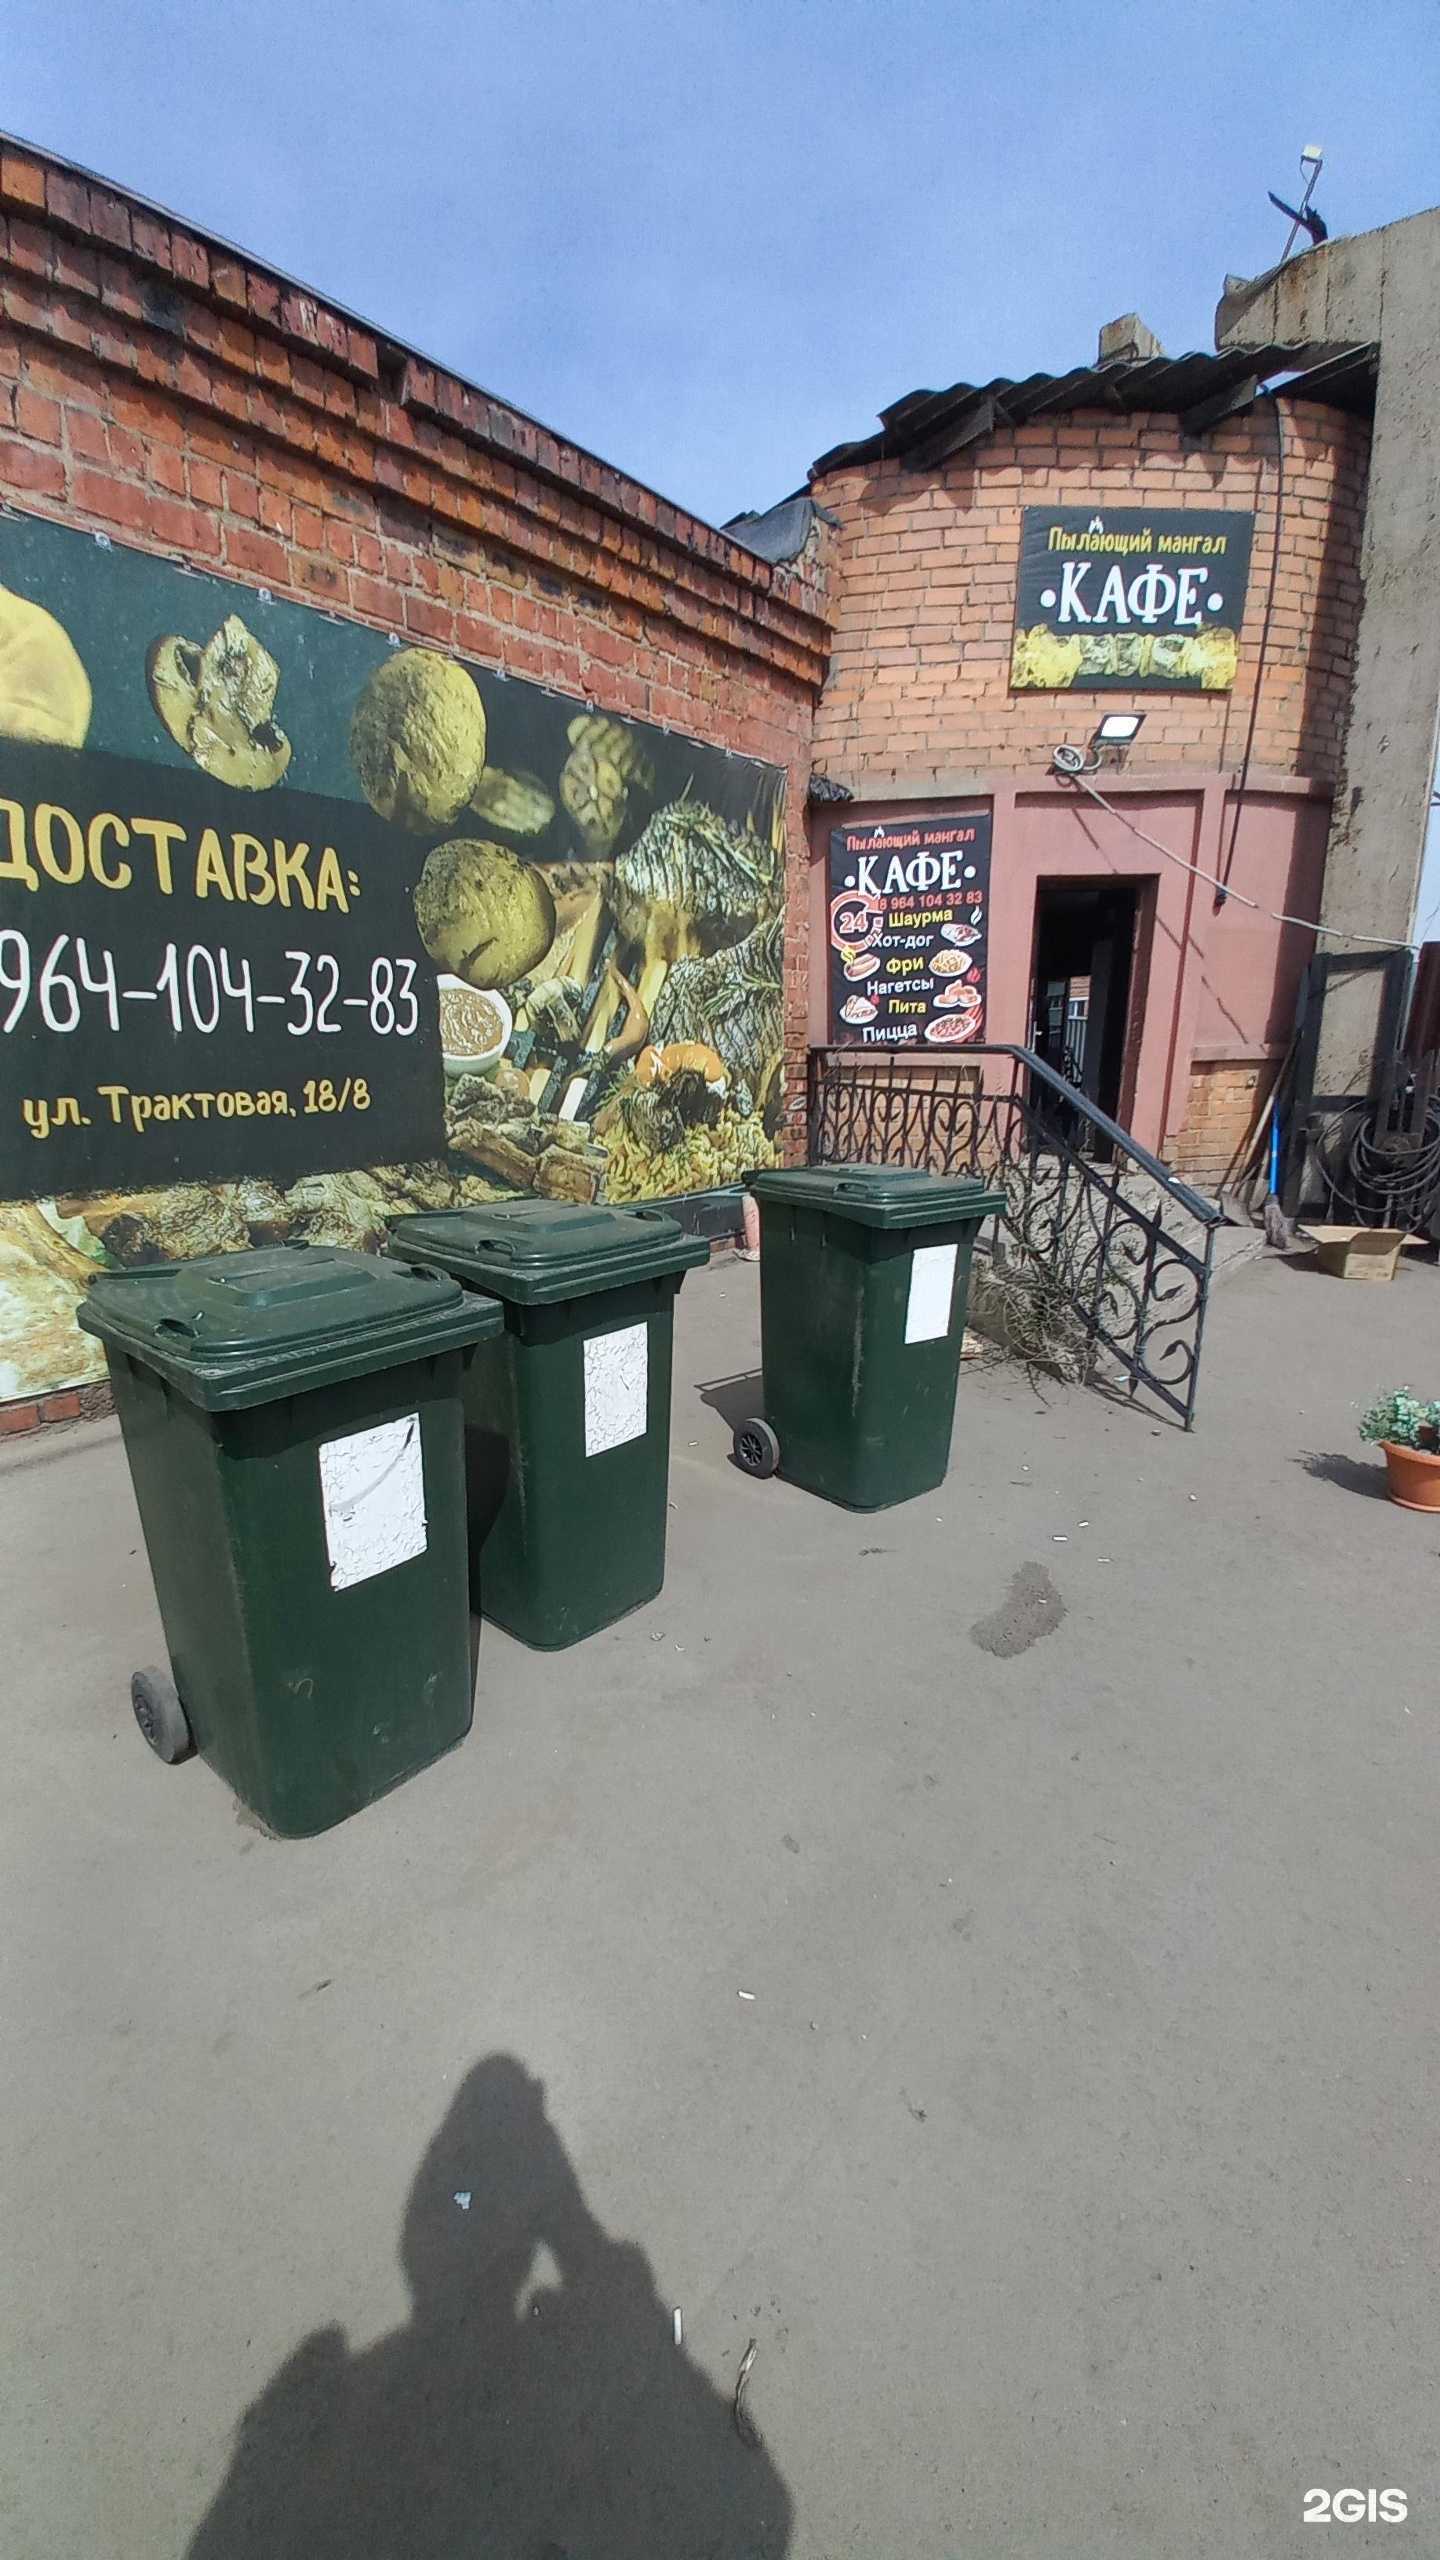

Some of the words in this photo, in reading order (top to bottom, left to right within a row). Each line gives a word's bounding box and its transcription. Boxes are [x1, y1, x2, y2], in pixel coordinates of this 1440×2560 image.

[1048, 526, 1153, 556] Пылающий
[1157, 534, 1228, 555] мангал
[1058, 561, 1209, 625] КАФЕ
[846, 829, 922, 851] Пылающий
[924, 828, 976, 845] мангал
[919, 894, 943, 908] 104
[946, 892, 963, 905] 32
[966, 891, 984, 904] 83
[839, 910, 868, 934] 24
[888, 908, 953, 929] Шаурма
[872, 934, 935, 949] Хот-дог
[886, 956, 925, 976] Фри
[867, 977, 934, 996] Нагетсы
[888, 999, 927, 1014] Пита
[862, 1023, 918, 1043] Пицца
[23, 1098, 91, 1139] ул.
[98, 1085, 297, 1132] Трактовая,
[302, 1078, 371, 1114] 18/8
